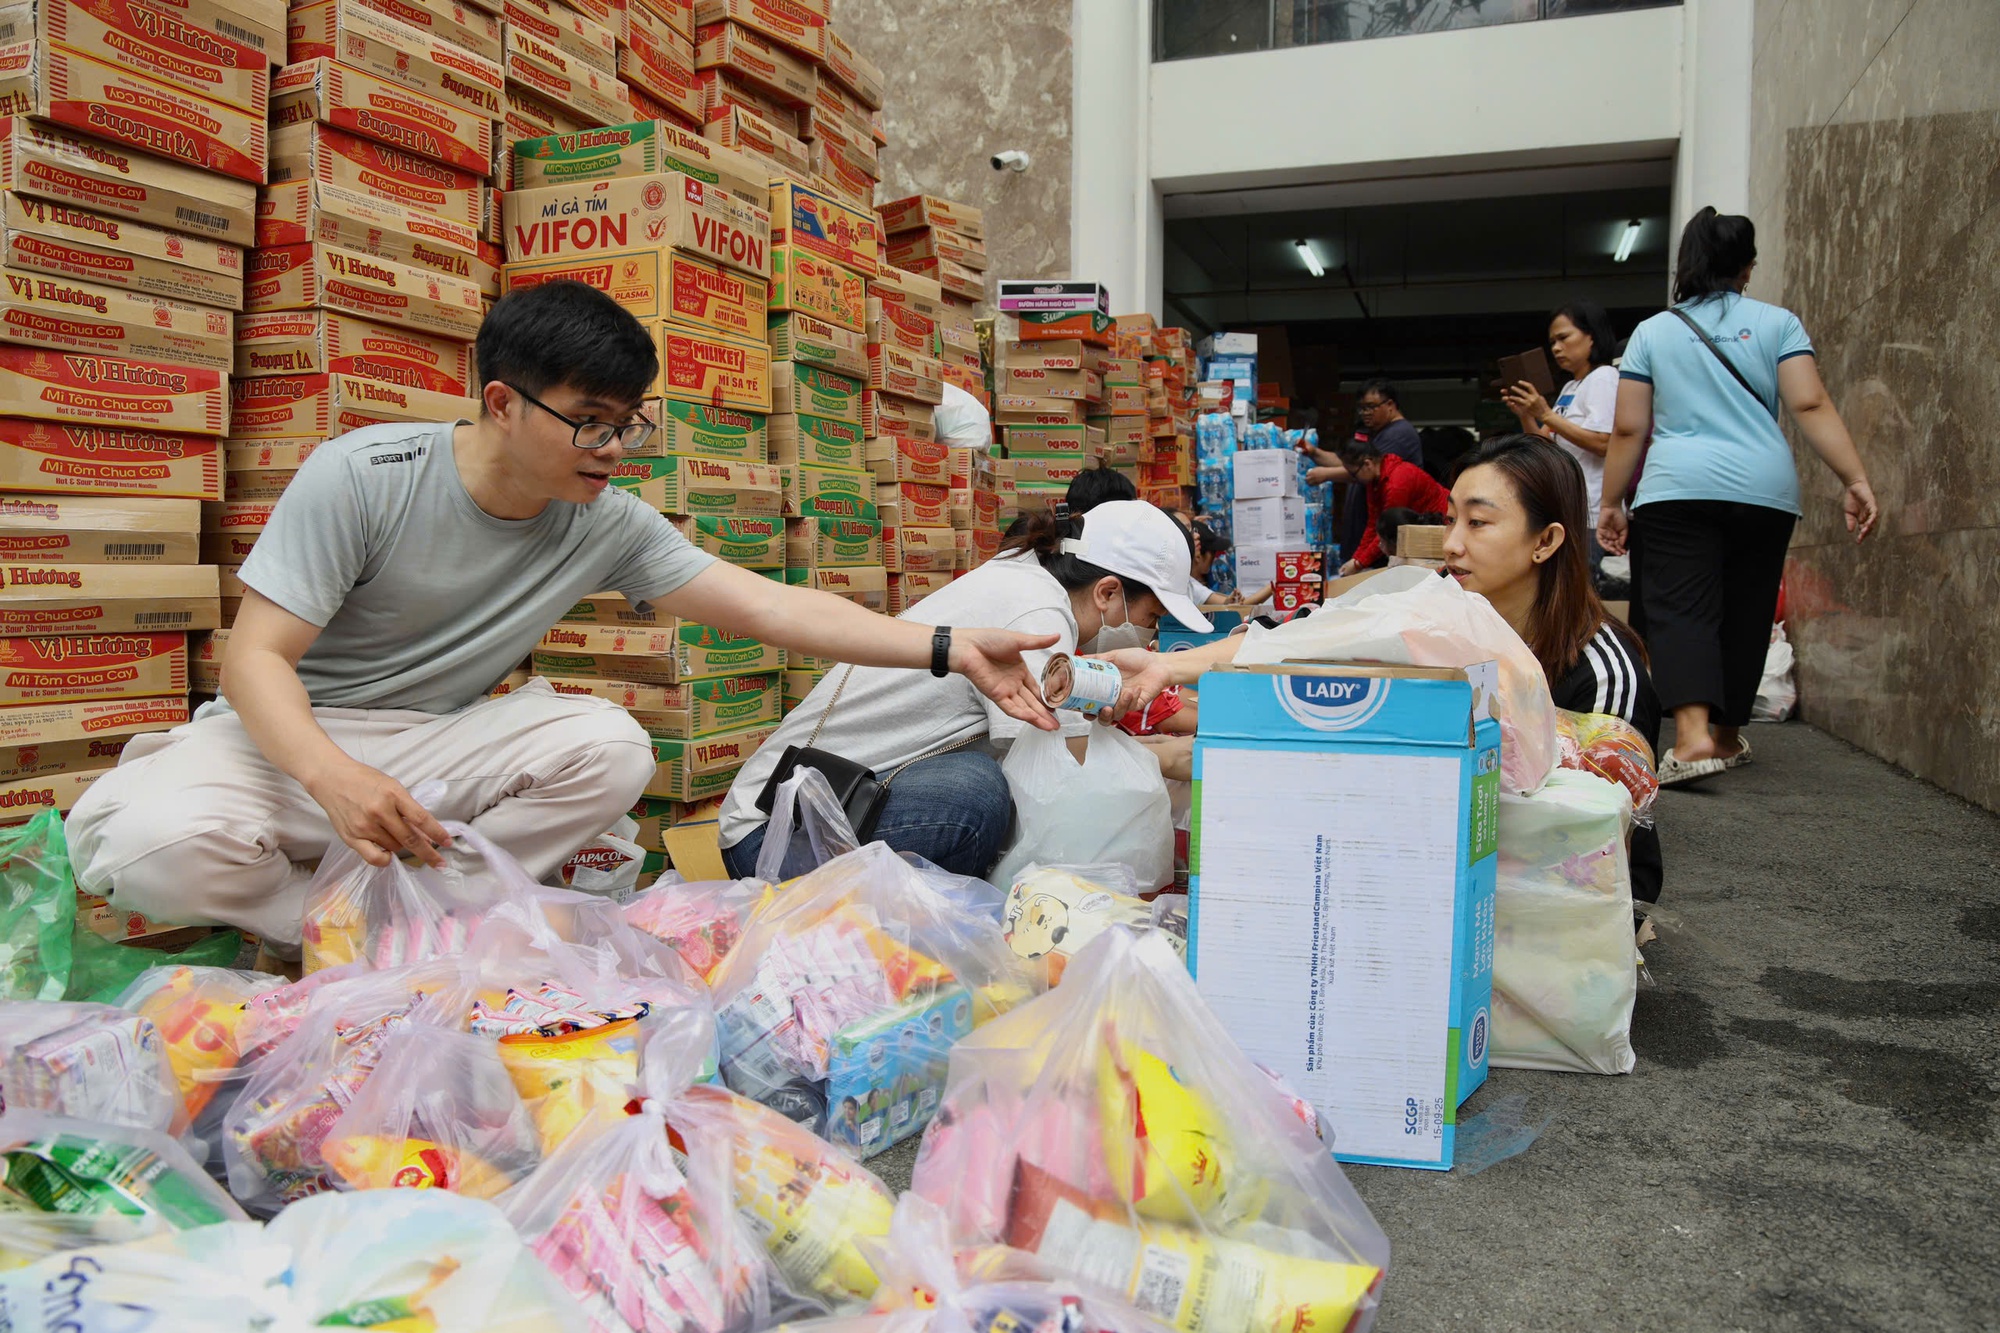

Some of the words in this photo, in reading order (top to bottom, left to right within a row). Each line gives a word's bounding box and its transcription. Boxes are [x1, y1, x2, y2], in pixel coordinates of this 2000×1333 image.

[128, 5, 156, 36] Vị
[162, 18, 235, 66] Hương
[109, 35, 125, 47] Mì
[129, 43, 155, 61] Tôm
[158, 55, 191, 74] Chua
[195, 68, 219, 82] Cay
[90, 104, 170, 152] Hương
[358, 111, 418, 148] Hương
[175, 133, 200, 161] Vị
[421, 132, 442, 157] Vị
[558, 135, 575, 152] Vị
[579, 130, 630, 149] Hương
[665, 127, 677, 147] Vị
[679, 132, 710, 160] Hương
[362, 174, 374, 184] Mì
[377, 178, 396, 192] Tôm
[399, 187, 423, 199] Chua
[425, 193, 443, 204] Cay
[686, 191, 702, 202] VIFON
[542, 199, 557, 218] MÌ
[561, 196, 579, 214] GÀ
[585, 194, 607, 212] TÍM
[21, 198, 44, 223] Vị
[51, 205, 119, 240] Hương
[515, 213, 627, 256] VIFON
[692, 212, 762, 270] VIFON
[326, 252, 345, 275] Vị
[348, 258, 396, 287] Hương
[6, 275, 32, 300] Vị
[37, 280, 107, 313] Hương
[615, 290, 649, 300] PLASMA
[697, 270, 739, 298] MILIKET
[10, 312, 26, 323] Mì
[31, 316, 55, 330] Tôm
[60, 323, 92, 335] Chua
[99, 327, 120, 338] Cay
[715, 309, 730, 321] SATAY
[731, 315, 747, 327] FLAVOR
[798, 317, 808, 334] Vị
[809, 320, 832, 340] Hương
[10, 328, 23, 337] Hot
[32, 331, 49, 340] Sour
[52, 334, 77, 345] Shrimp
[693, 342, 740, 366] MILIKET
[64, 356, 98, 382] Vị
[102, 362, 186, 392] Hương
[718, 373, 729, 385] MÌ
[732, 378, 744, 389] SA
[746, 377, 758, 391] TẾ
[47, 390, 64, 401] Mì
[69, 392, 97, 406] Tôm
[102, 399, 138, 410] Chua
[142, 401, 168, 411] Cay
[250, 379, 304, 400] Hương
[77, 409, 94, 417] Sour
[96, 411, 119, 419] Shrimp
[703, 406, 716, 426] Vị
[718, 409, 752, 431] Hương
[64, 426, 96, 451] Vị
[101, 429, 183, 457] Hương
[46, 462, 62, 472] Mì
[68, 463, 95, 476] Tôm
[100, 467, 136, 477] Chua
[139, 467, 165, 477] Cay
[372, 455, 401, 464] SPORT
[688, 460, 700, 478] Vị
[702, 460, 730, 480] Hương
[9, 567, 82, 588] Hương
[29, 637, 64, 660] Vị
[68, 637, 151, 657] Hương
[12, 675, 30, 685] Mì
[34, 674, 62, 685] Tôm
[67, 673, 103, 684] Chua
[107, 668, 133, 680] Cay
[1306, 682, 1355, 698] LADY
[696, 748, 708, 764] Vị
[709, 743, 739, 760] Hương
[1475, 821, 1483, 853] Sữa
[568, 852, 624, 864] HAPACOL
[1313, 857, 1322, 873] Việt
[1311, 875, 1322, 951] FrieslandCampina
[1474, 901, 1481, 927] Mẽ
[1472, 930, 1481, 978] Mạnh
[1312, 979, 1319, 988] ty
[1309, 990, 1318, 1010] Công
[1307, 1012, 1316, 1030] của:
[1306, 1032, 1317, 1055] phẩm
[1306, 1057, 1315, 1072] Sản
[1405, 1098, 1418, 1135] SCGP
[1434, 1098, 1443, 1139] 15-09-25
